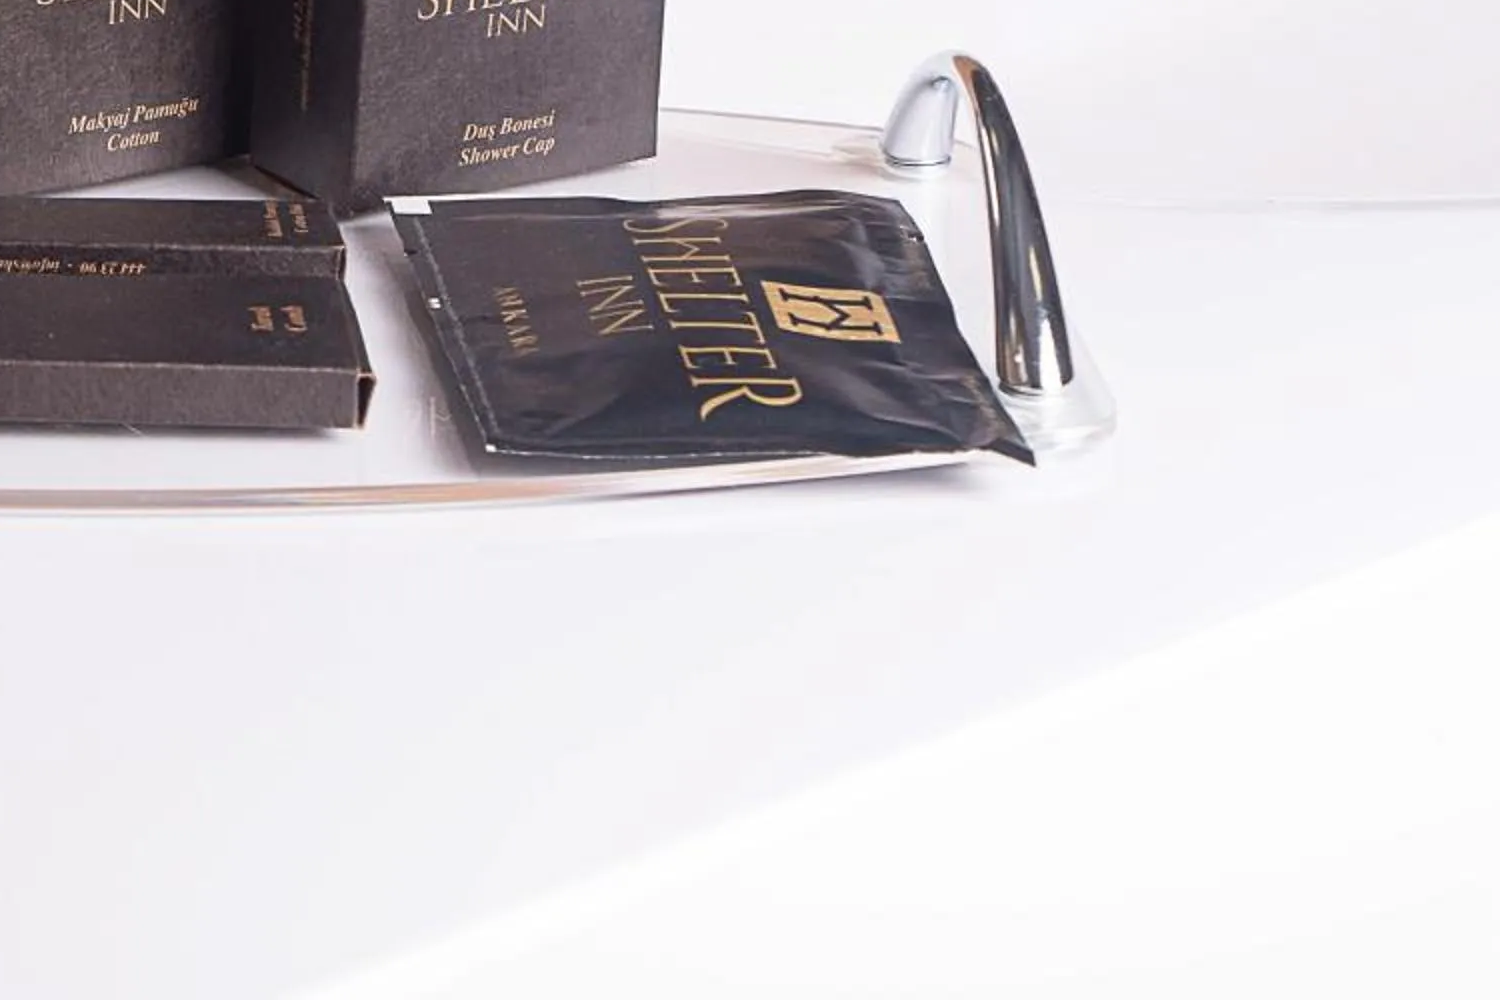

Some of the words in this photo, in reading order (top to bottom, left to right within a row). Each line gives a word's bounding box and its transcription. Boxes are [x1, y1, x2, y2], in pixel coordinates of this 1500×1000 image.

[486, 5, 547, 39] INN
[68, 107, 131, 135] Makyaj
[132, 97, 199, 123] Pamuğu
[463, 123, 497, 142] Duş
[499, 109, 556, 135] Bonesi
[107, 131, 161, 152] Cotton
[458, 144, 521, 167] Shower
[523, 136, 556, 156] Cap
[576, 275, 655, 335] INN
[624, 217, 803, 421] SHELTER
